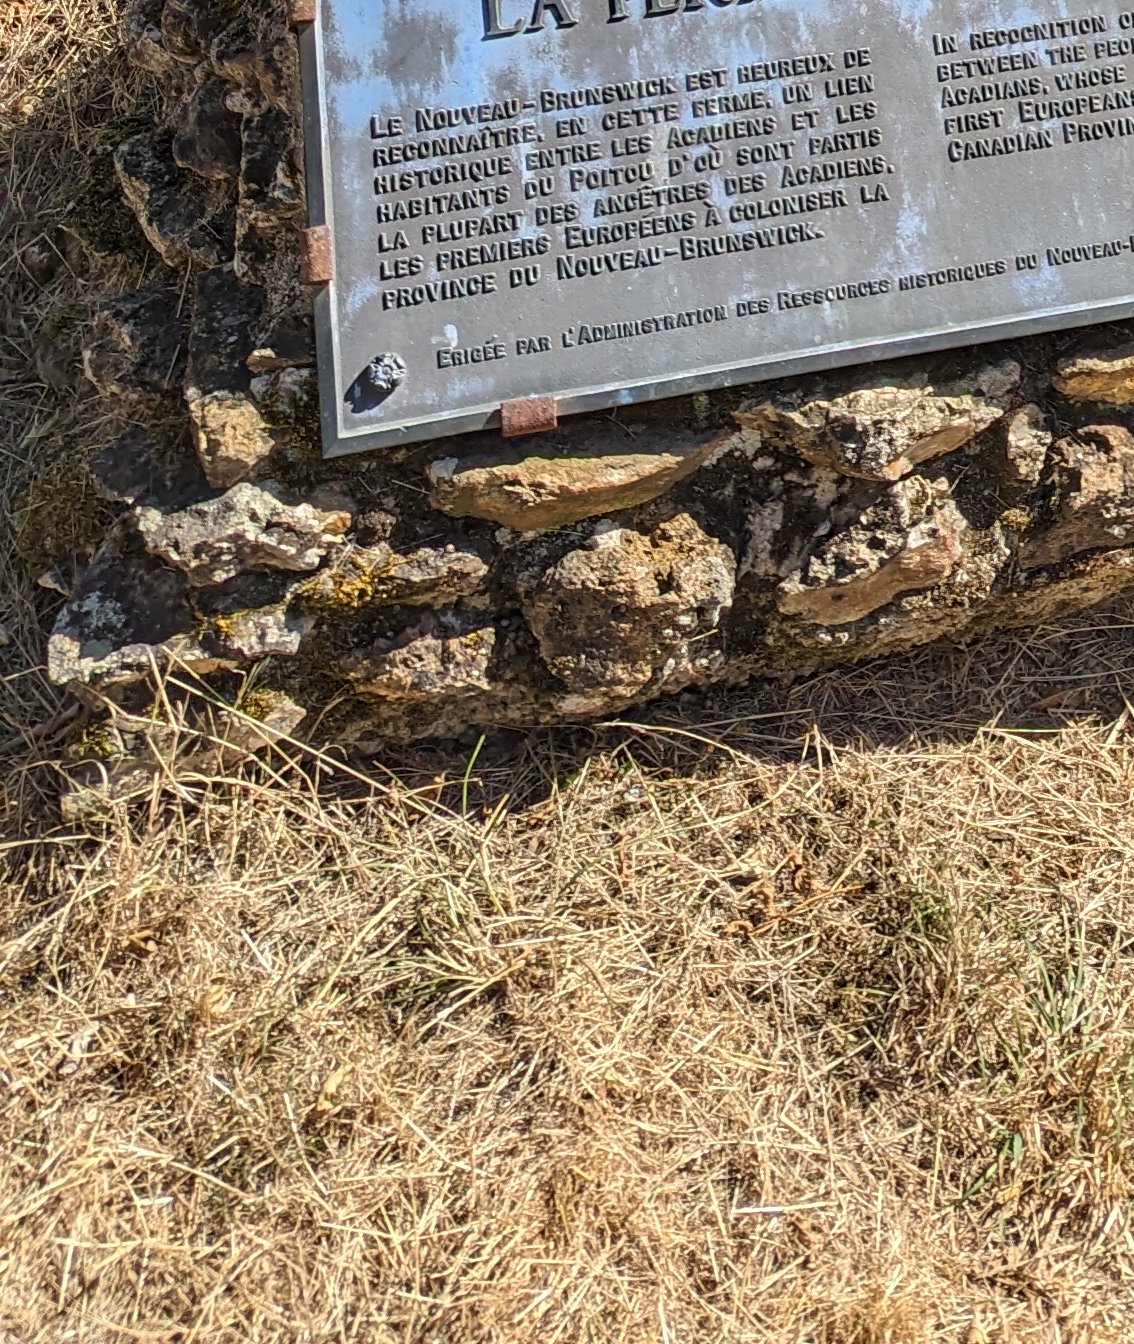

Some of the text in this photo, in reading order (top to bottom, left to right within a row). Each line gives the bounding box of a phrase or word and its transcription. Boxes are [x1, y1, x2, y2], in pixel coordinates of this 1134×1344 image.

[933, 32, 958, 55] IN
[970, 14, 1107, 50] RECOGNITION
[937, 49, 1039, 82] BETWEEN
[1045, 43, 1087, 66] THE
[371, 115, 403, 138] LE
[686, 69, 728, 92] EST
[737, 52, 835, 83] HEUREUX
[844, 47, 873, 68] DE
[557, 116, 589, 137] EN
[602, 101, 680, 131] CETTE
[783, 83, 813, 104] UN
[825, 74, 875, 98] LIEN
[1055, 65, 1127, 92] WHOSE
[374, 100, 878, 194] HISTORIQUE ENTRE LES ACADIENS ET LES
[945, 108, 1005, 135] FIRST
[948, 130, 1053, 162] CANADIAN
[377, 184, 511, 223] HABITANTS
[525, 176, 555, 199] DU
[570, 161, 655, 191] POITOU
[736, 140, 795, 166] SONT
[809, 127, 883, 155] PARTIS
[378, 230, 410, 253] LA
[422, 210, 524, 244] PLUPART
[536, 202, 580, 226] DES
[594, 180, 711, 217] ANCÊTRES
[725, 172, 767, 195] DES
[380, 255, 424, 280] LES
[437, 234, 551, 271] PREMIERS
[703, 200, 722, 227] À
[729, 189, 848, 223] COLONISER
[860, 183, 891, 204] LA
[383, 273, 497, 310] PROVINCE
[510, 264, 542, 288] DU
[516, 336, 552, 356] PAR
[736, 298, 770, 317] DES
[777, 279, 891, 310] RESSOURCES
[899, 259, 1007, 291] HISTORIQUES
[1015, 254, 1037, 271] DU
